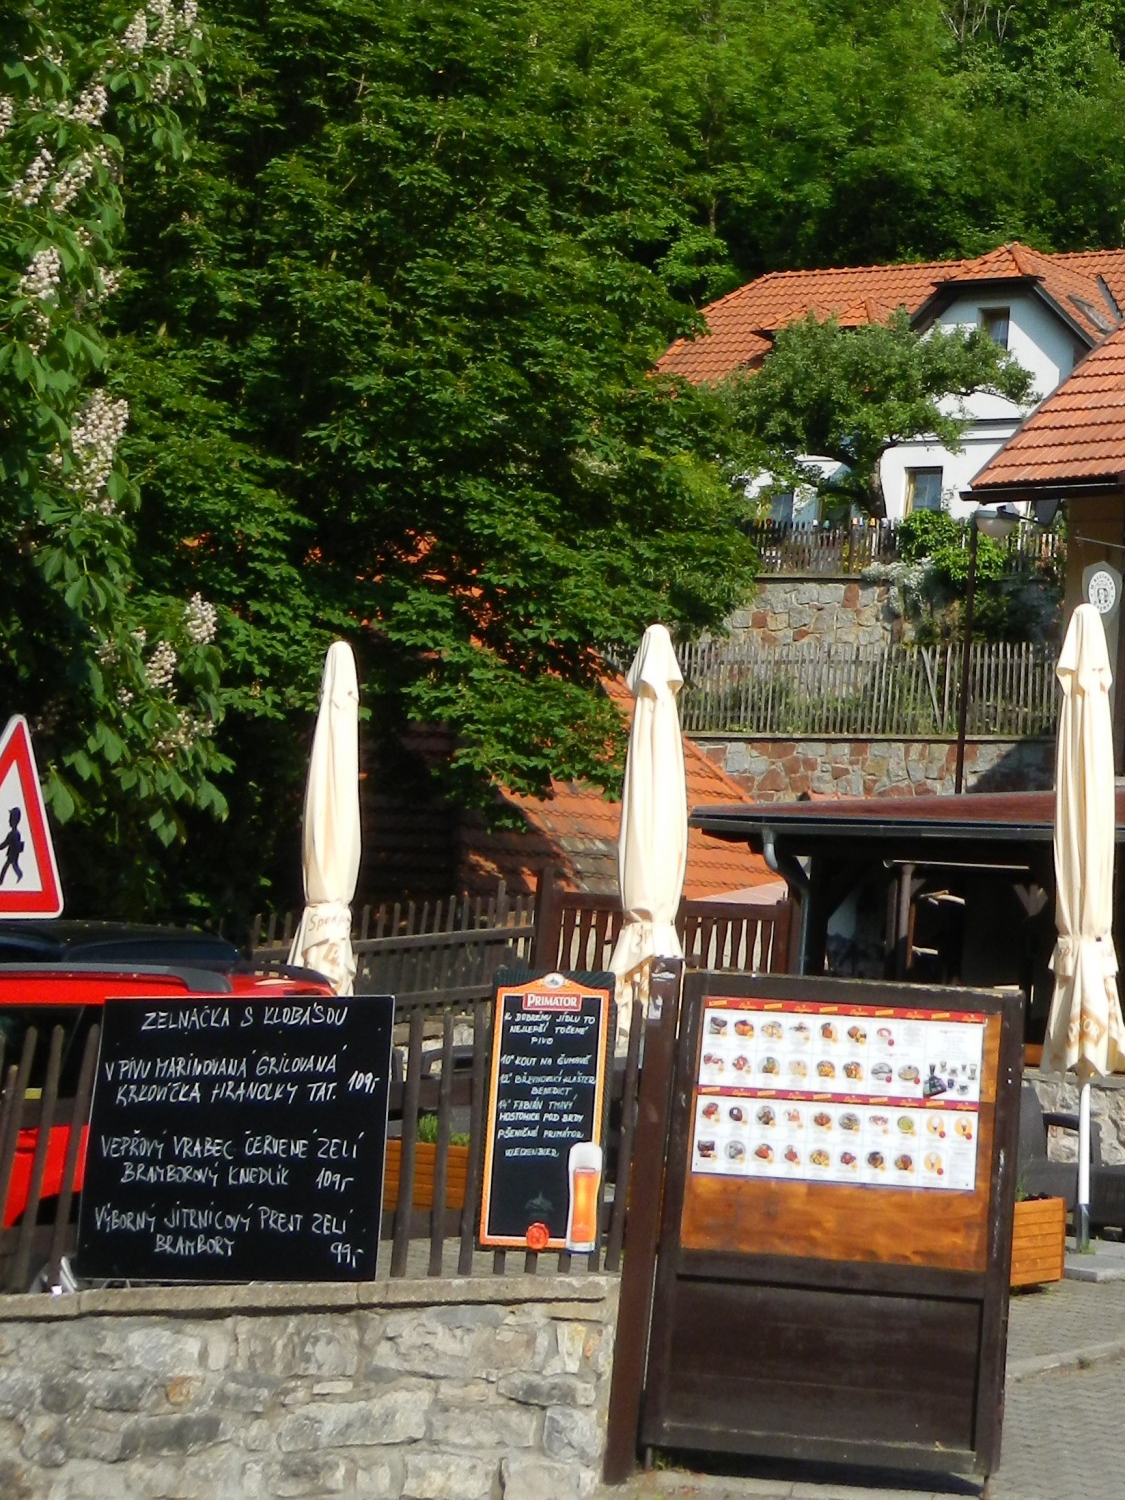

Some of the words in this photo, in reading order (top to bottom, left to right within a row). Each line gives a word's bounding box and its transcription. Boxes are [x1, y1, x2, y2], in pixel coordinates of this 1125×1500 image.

[526, 993, 578, 1008] PRIMATOR
[141, 1005, 230, 1030] ZELNAČKA
[240, 1006, 254, 1027] S
[263, 1002, 348, 1026] KLOBÁSOU
[583, 1016, 596, 1025] TO
[530, 1036, 554, 1045] PIVO
[514, 1056, 537, 1067] KOUT
[540, 1057, 553, 1066] NA
[105, 1062, 115, 1081] V
[210, 1081, 299, 1104] HRANOLKY
[307, 1082, 337, 1102] TAT.
[542, 1112, 560, 1123] POD
[173, 1136, 234, 1160] VRABEC
[120, 1161, 218, 1187] BRAMBOROVÝ
[154, 1234, 235, 1257] BRAMBORY
